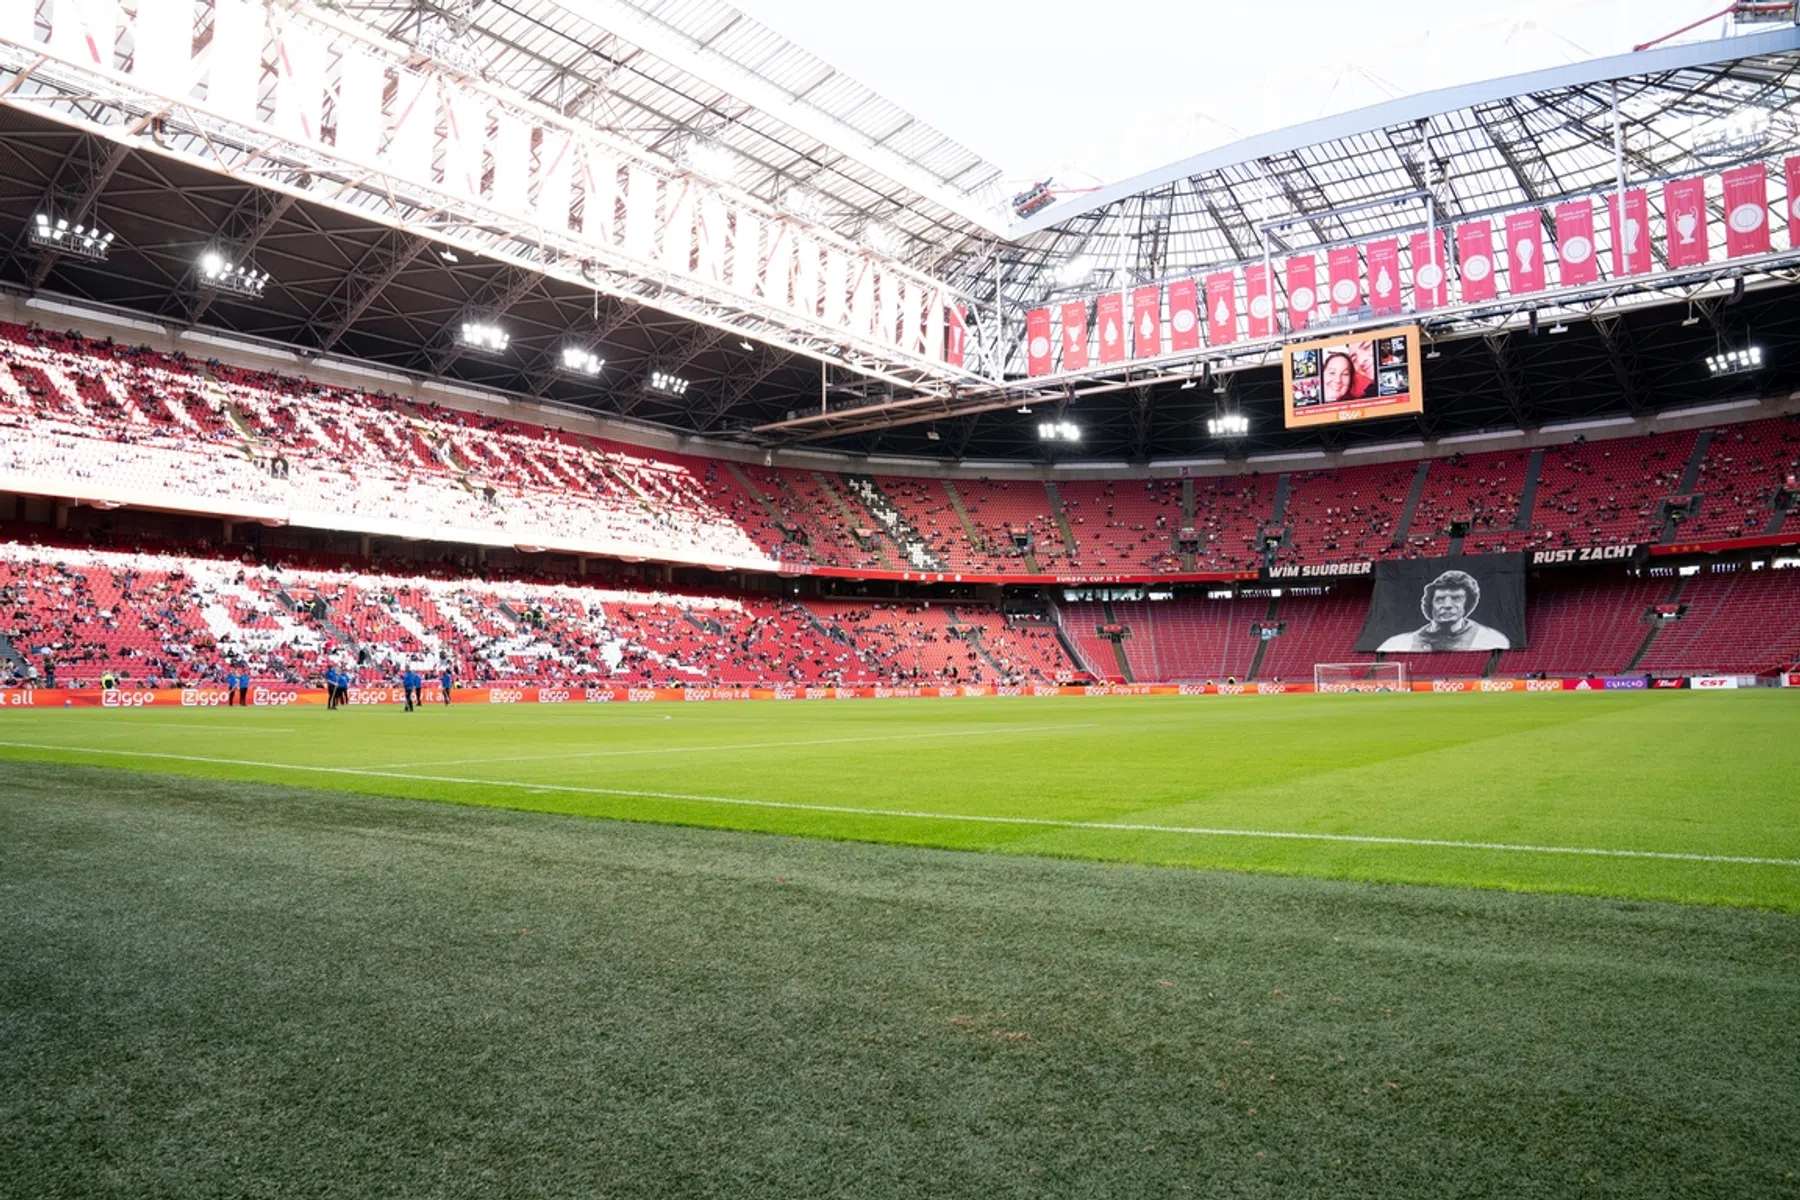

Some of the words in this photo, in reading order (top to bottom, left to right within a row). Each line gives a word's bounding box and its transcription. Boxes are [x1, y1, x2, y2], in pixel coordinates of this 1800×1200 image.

[1533, 549, 1576, 564] RUST
[1579, 544, 1637, 560] ZACHT
[1269, 566, 1299, 578] WIM
[1302, 562, 1372, 576] SUURBIER
[1178, 684, 1205, 695] Ziggo
[1217, 684, 1245, 695] Ziggo
[1257, 683, 1286, 694] Ziggo
[1432, 680, 1464, 692] Ziggo
[1480, 680, 1513, 692] Ziggo
[1526, 680, 1559, 691] Ziggo
[11, 690, 34, 704] all
[102, 689, 154, 706] Ziggo
[181, 689, 229, 706] Ziggo
[253, 687, 297, 705] Ziggo
[347, 687, 387, 704] Ziggo
[489, 688, 523, 702] Ziggo
[538, 688, 569, 702] Ziggo
[586, 688, 615, 702] Ziggo
[628, 688, 655, 702] Ziggo
[685, 688, 710, 701] Ziggo
